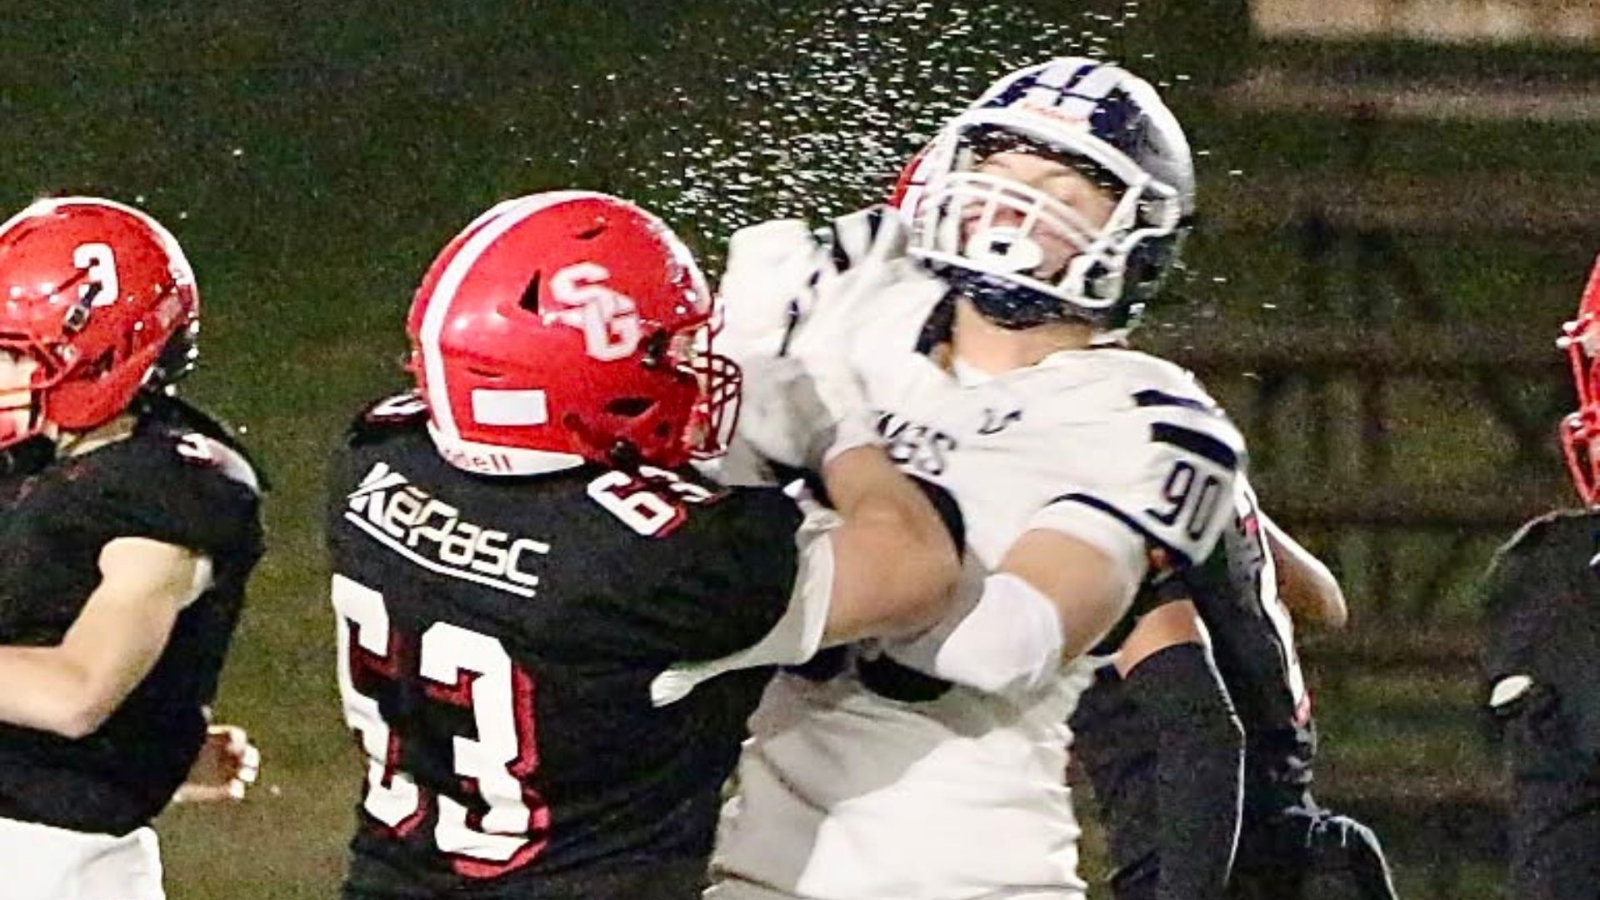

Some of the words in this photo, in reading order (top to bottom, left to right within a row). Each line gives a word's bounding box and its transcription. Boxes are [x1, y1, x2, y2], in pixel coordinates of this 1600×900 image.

[73, 242, 120, 307] 3
[549, 261, 643, 363] SG
[586, 465, 716, 537] 63
[1146, 460, 1221, 541] 90
[331, 573, 552, 878] 63
